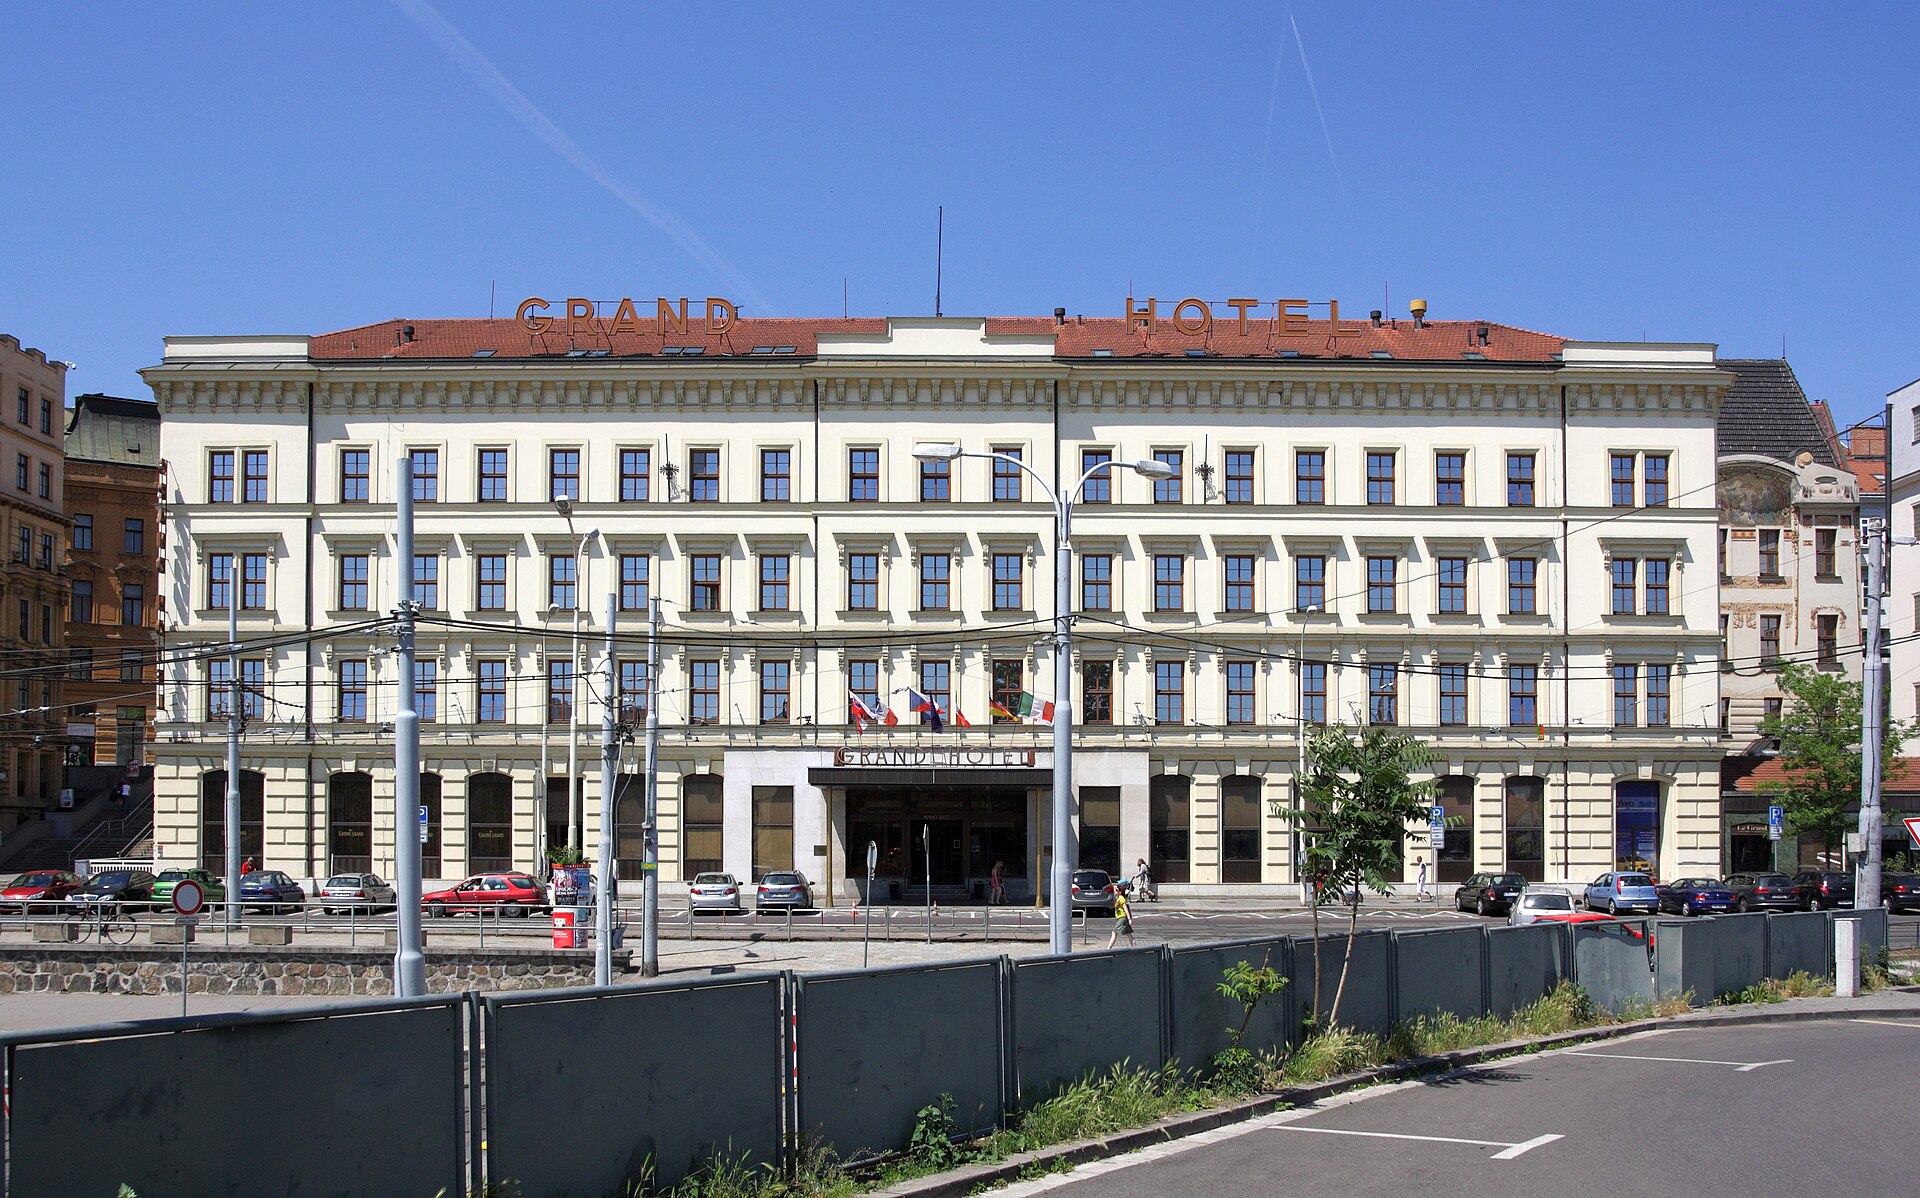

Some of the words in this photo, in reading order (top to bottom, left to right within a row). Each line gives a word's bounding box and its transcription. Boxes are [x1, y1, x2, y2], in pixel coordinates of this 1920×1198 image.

[515, 297, 737, 336] GRAND
[1125, 297, 1362, 337] HOTEL
[837, 746, 926, 766] GRAND
[949, 747, 1030, 766] HOTEL
[1772, 809, 1780, 820] P
